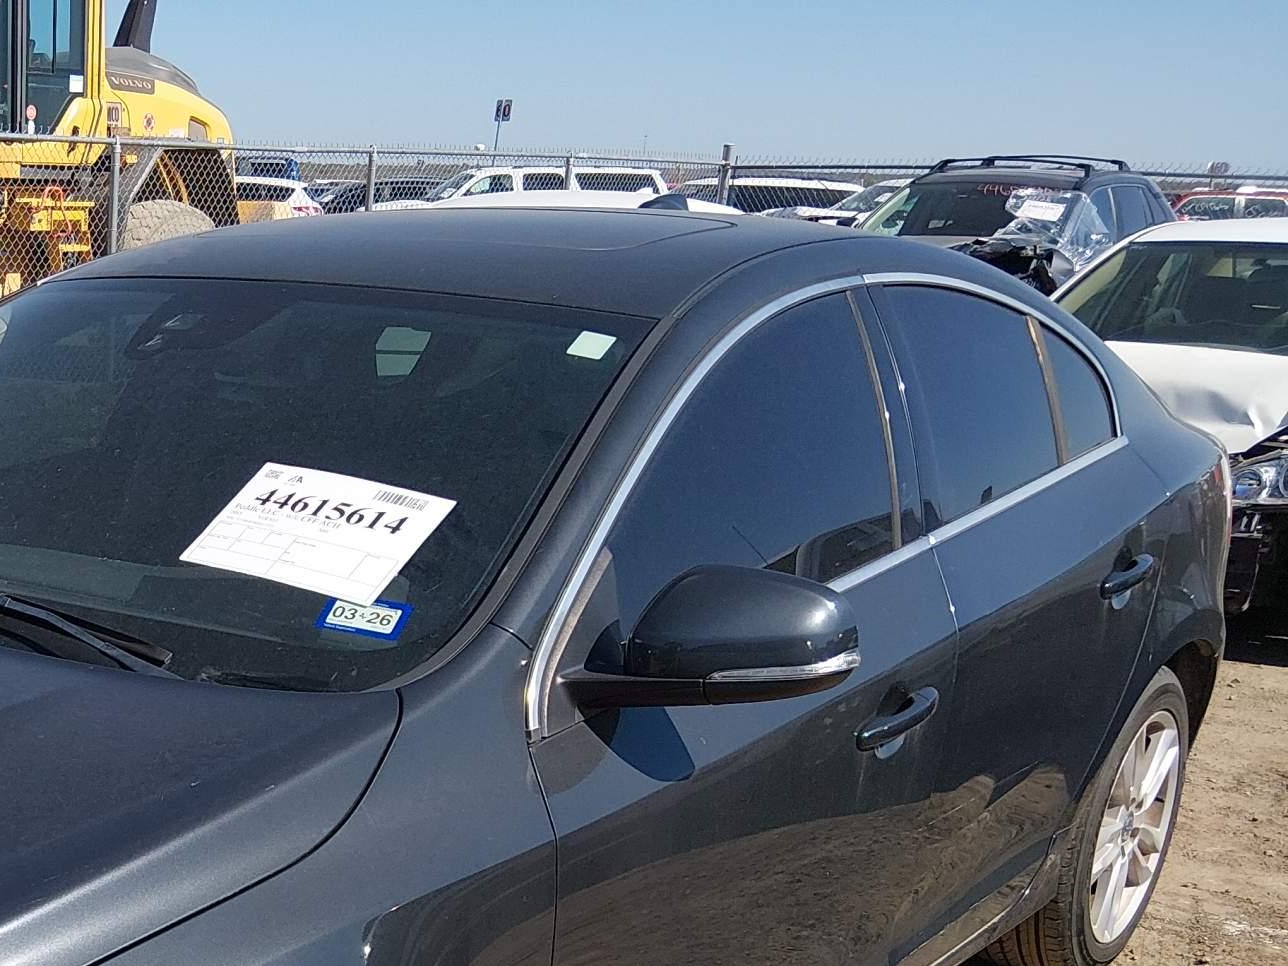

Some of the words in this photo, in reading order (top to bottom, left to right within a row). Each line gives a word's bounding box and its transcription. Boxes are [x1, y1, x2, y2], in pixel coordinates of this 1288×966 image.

[111, 76, 152, 89] VOLVO
[254, 488, 409, 535] 44615614
[365, 611, 393, 627] 26
